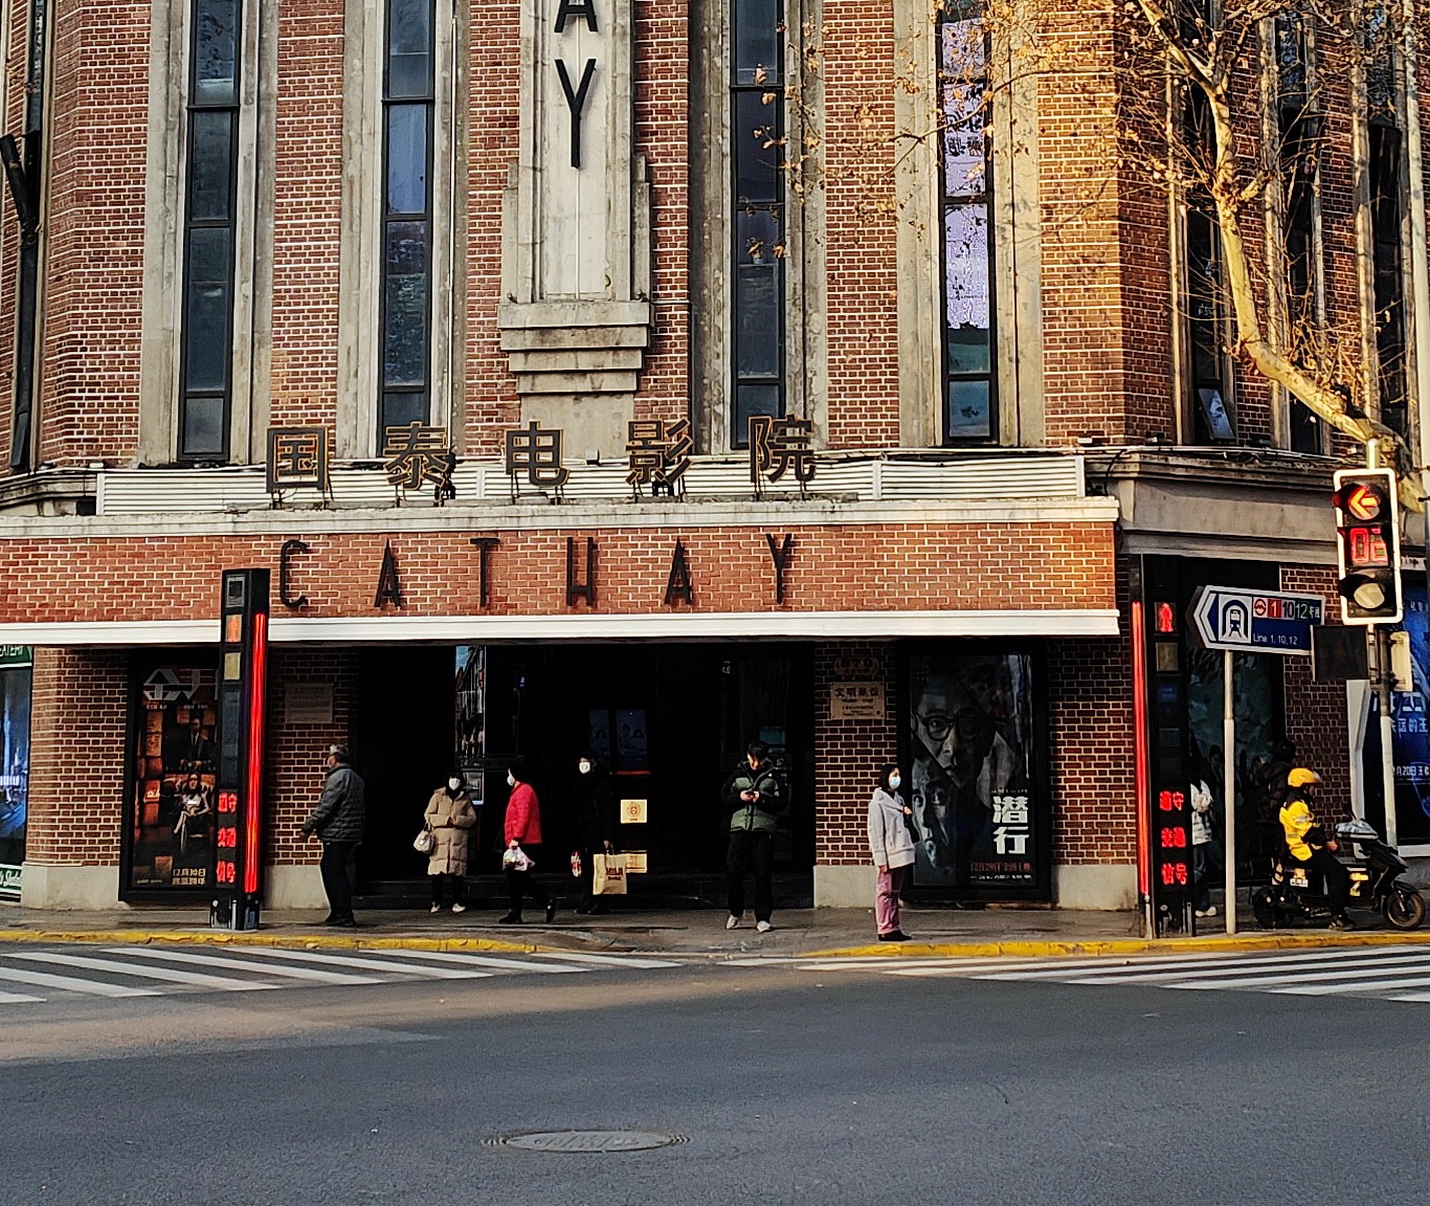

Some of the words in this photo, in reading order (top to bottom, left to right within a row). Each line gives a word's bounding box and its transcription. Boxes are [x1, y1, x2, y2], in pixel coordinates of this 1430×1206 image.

[266, 416, 816, 493] 国泰电影院
[279, 534, 792, 608] CATHAY
[1253, 633, 1267, 643] Line
[1283, 601, 1295, 619] 10
[1296, 602, 1308, 619] 12
[993, 796, 1030, 854] 潜行
